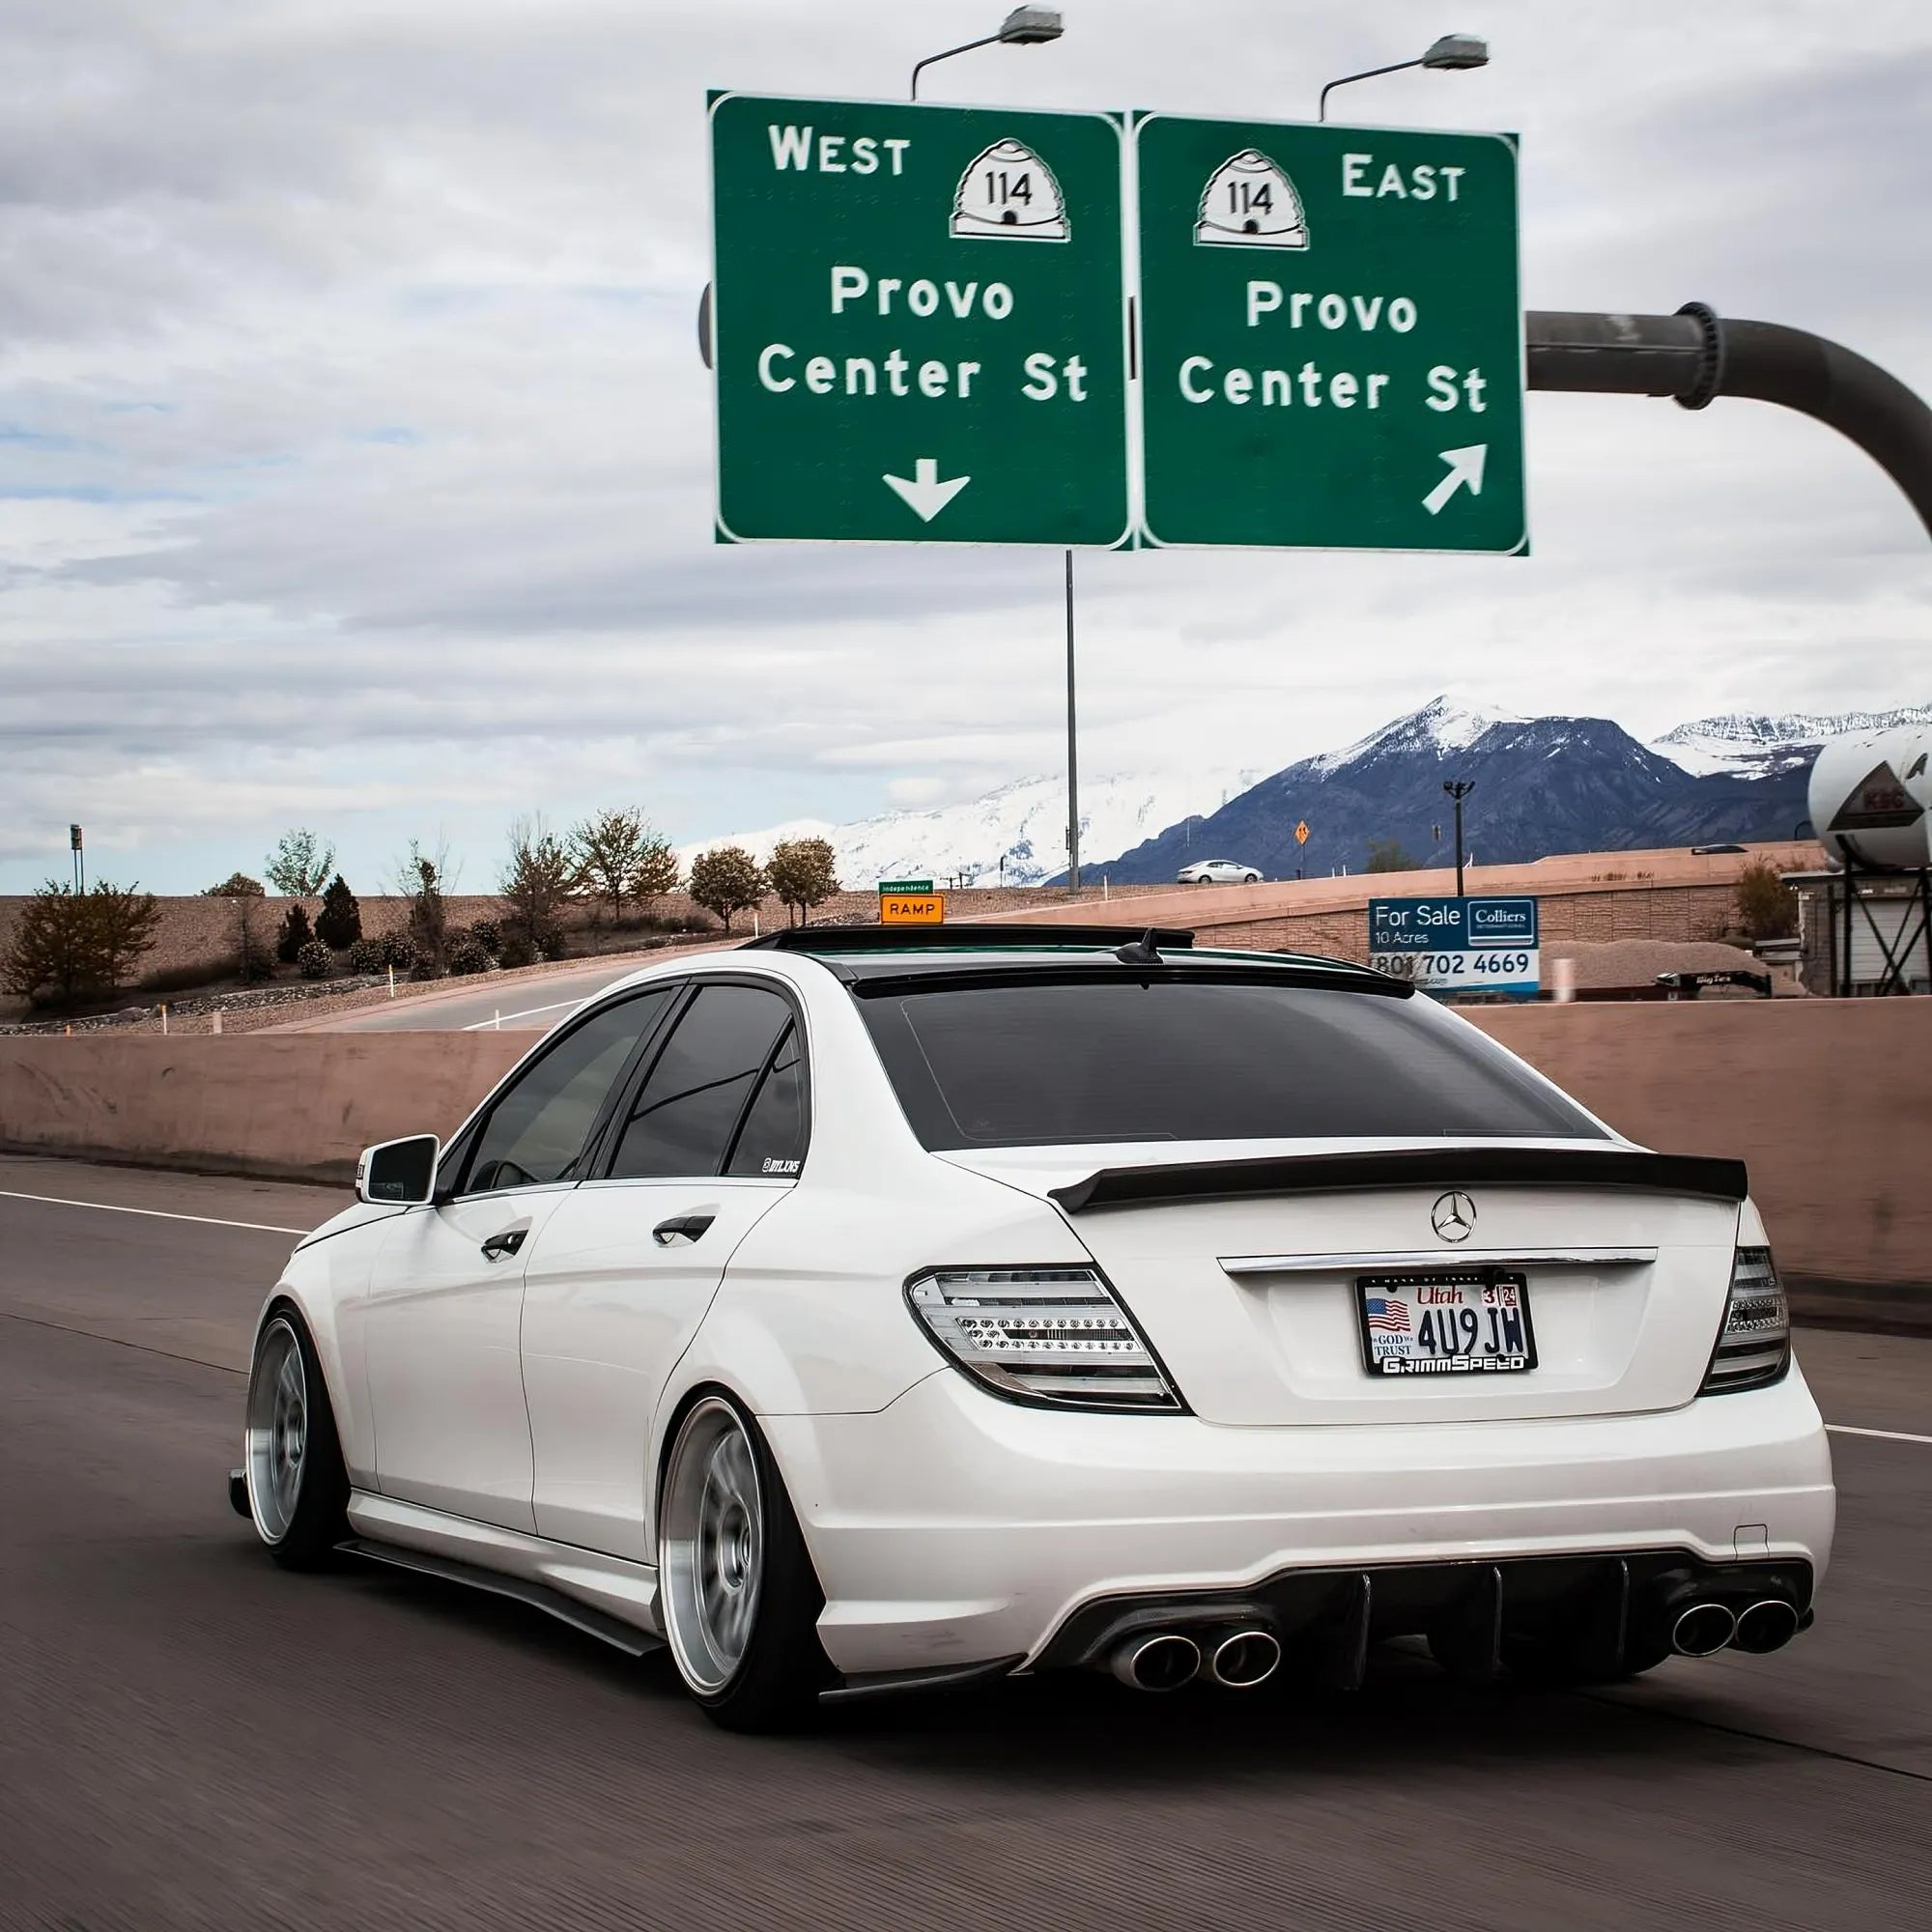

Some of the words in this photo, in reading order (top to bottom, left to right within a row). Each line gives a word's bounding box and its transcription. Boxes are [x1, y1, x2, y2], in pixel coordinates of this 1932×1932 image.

[768, 124, 911, 176] WEST
[985, 171, 1033, 206] 114
[1342, 153, 1466, 202] EAST
[1227, 181, 1274, 215] 114
[831, 266, 1014, 320] Provo
[1246, 280, 1417, 333] Provo
[758, 343, 981, 398] Center
[1021, 353, 1088, 402] St
[1179, 355, 1390, 410] Center
[1425, 365, 1488, 412] St
[890, 903, 935, 915] RAMP
[1376, 906, 1409, 926] For
[1416, 904, 1461, 925] Sale
[1475, 909, 1526, 923] Colliers
[1376, 932, 1390, 944] 10
[1394, 930, 1430, 944] Acres
[1423, 954, 1465, 974] 702
[1473, 952, 1530, 974] 4669
[1417, 1287, 1463, 1304] Utah
[1483, 1289, 1496, 1304] 3
[1503, 1288, 1516, 1302] 24
[1378, 1334, 1404, 1345] GOD
[1418, 1309, 1478, 1354] 4U9
[1375, 1346, 1411, 1356] TRUST
